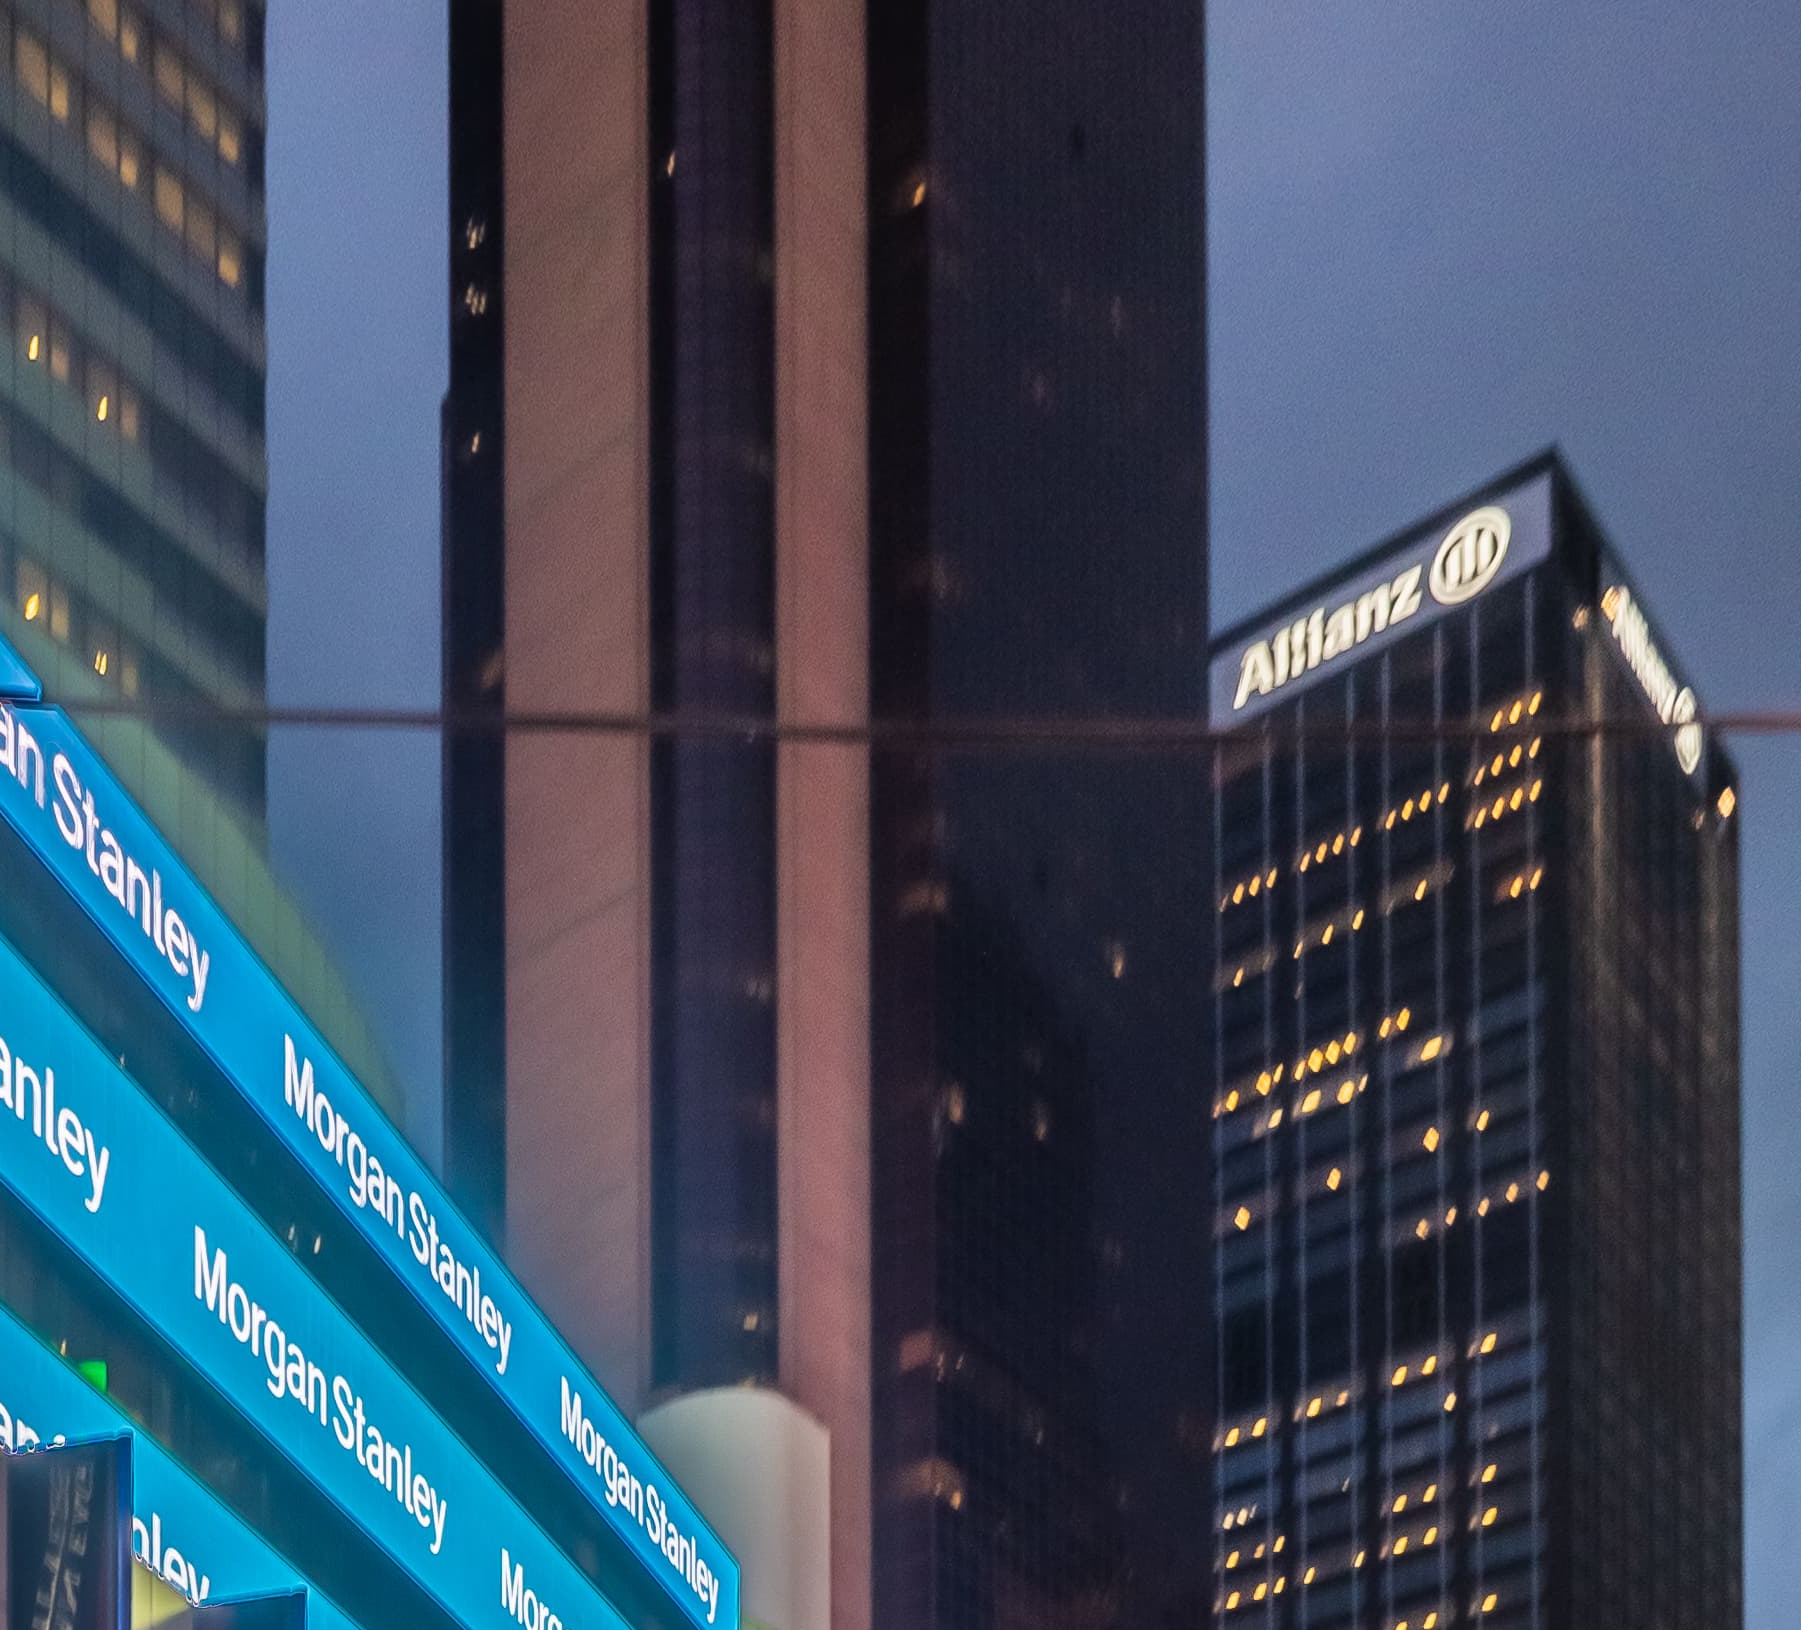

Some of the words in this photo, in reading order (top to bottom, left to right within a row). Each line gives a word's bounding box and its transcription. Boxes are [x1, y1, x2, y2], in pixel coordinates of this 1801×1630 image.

[1232, 564, 1423, 711] Allianz
[52, 753, 210, 1012] Stanley
[283, 1034, 404, 1239] Morgan
[409, 1192, 512, 1375] Stanley
[194, 1225, 327, 1427] Morgan
[332, 1376, 447, 1554] Stanley
[560, 1376, 643, 1527] Morgan
[646, 1487, 720, 1623] Stanley
